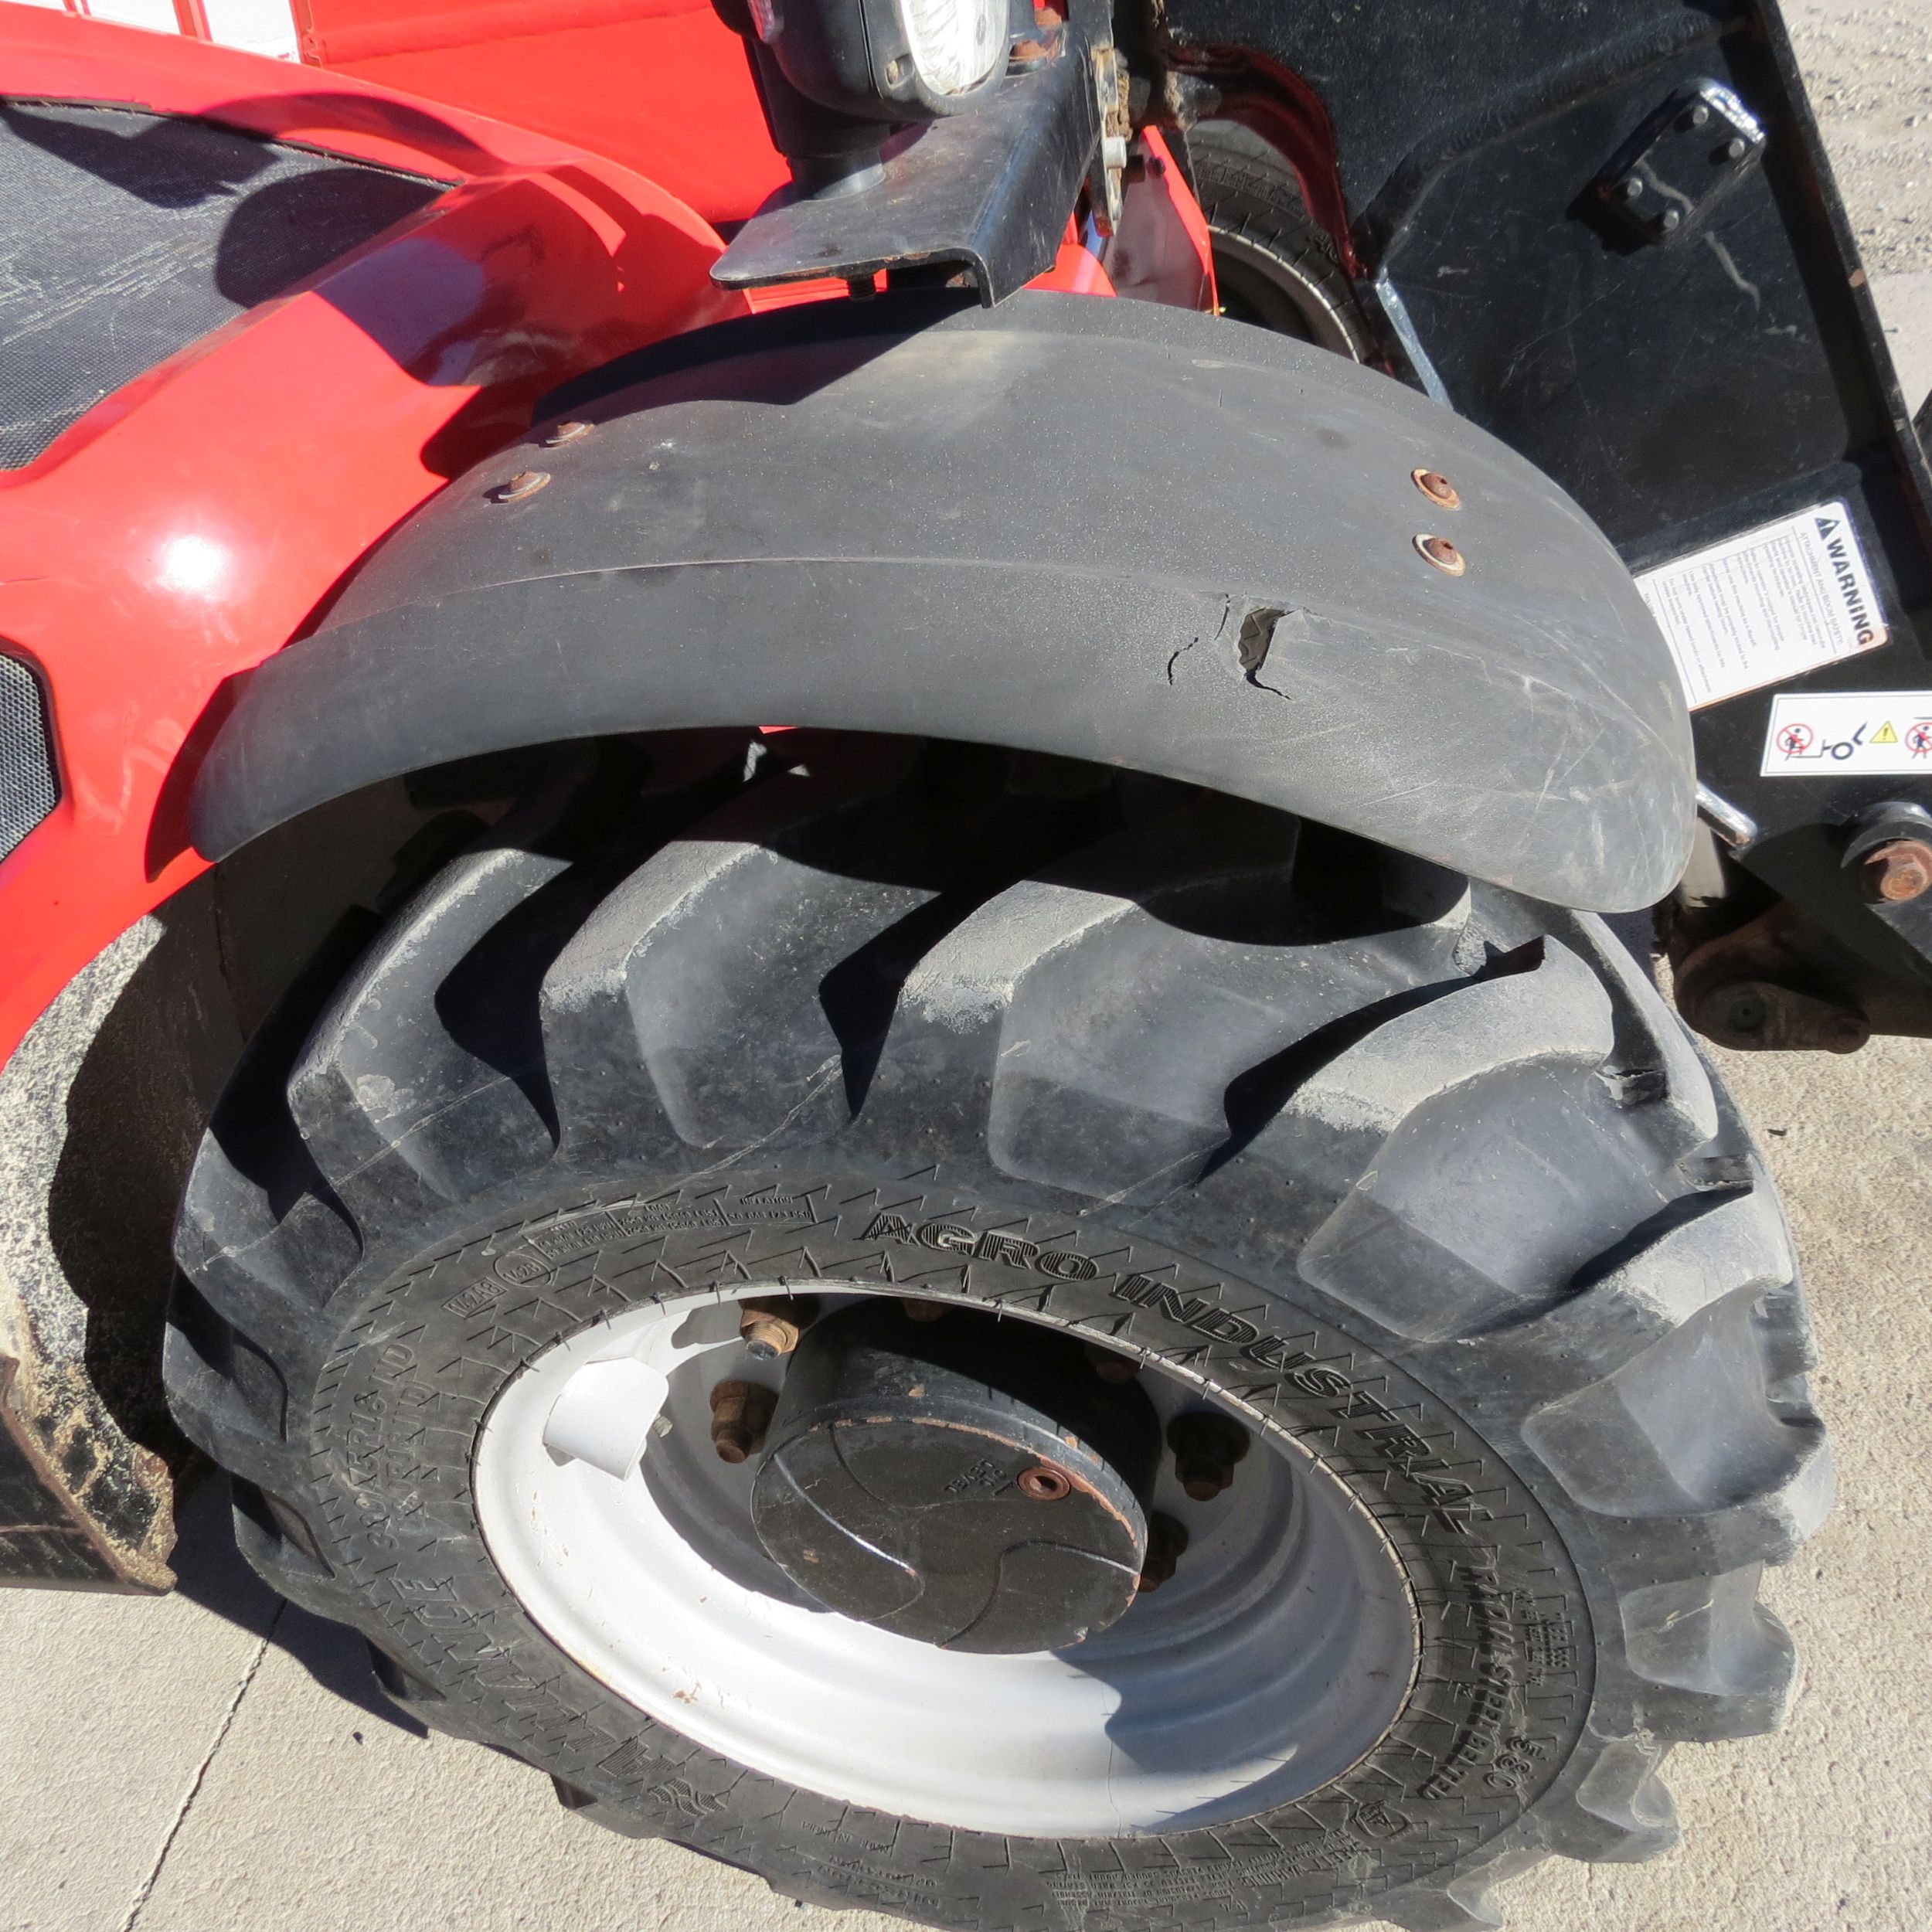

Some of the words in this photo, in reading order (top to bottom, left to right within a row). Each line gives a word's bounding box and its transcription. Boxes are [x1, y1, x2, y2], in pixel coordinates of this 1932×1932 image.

[1799, 531, 1821, 577] ATTACHMENT
[1821, 594, 1835, 617] BOOM
[1823, 536, 1876, 646] WARNING
[444, 1278, 503, 1316] 142A8
[500, 1260, 543, 1284] 142B
[859, 1212, 1100, 1282] AGRO
[1109, 1273, 1496, 1536] INDUSTRIAL
[944, 1458, 995, 1493] LEVEL
[1470, 1563, 1515, 1658] RADIAL
[1475, 1662, 1515, 1730] STEEL
[1421, 1730, 1495, 1802] BELTED
[1477, 1734, 1546, 1793] 580
